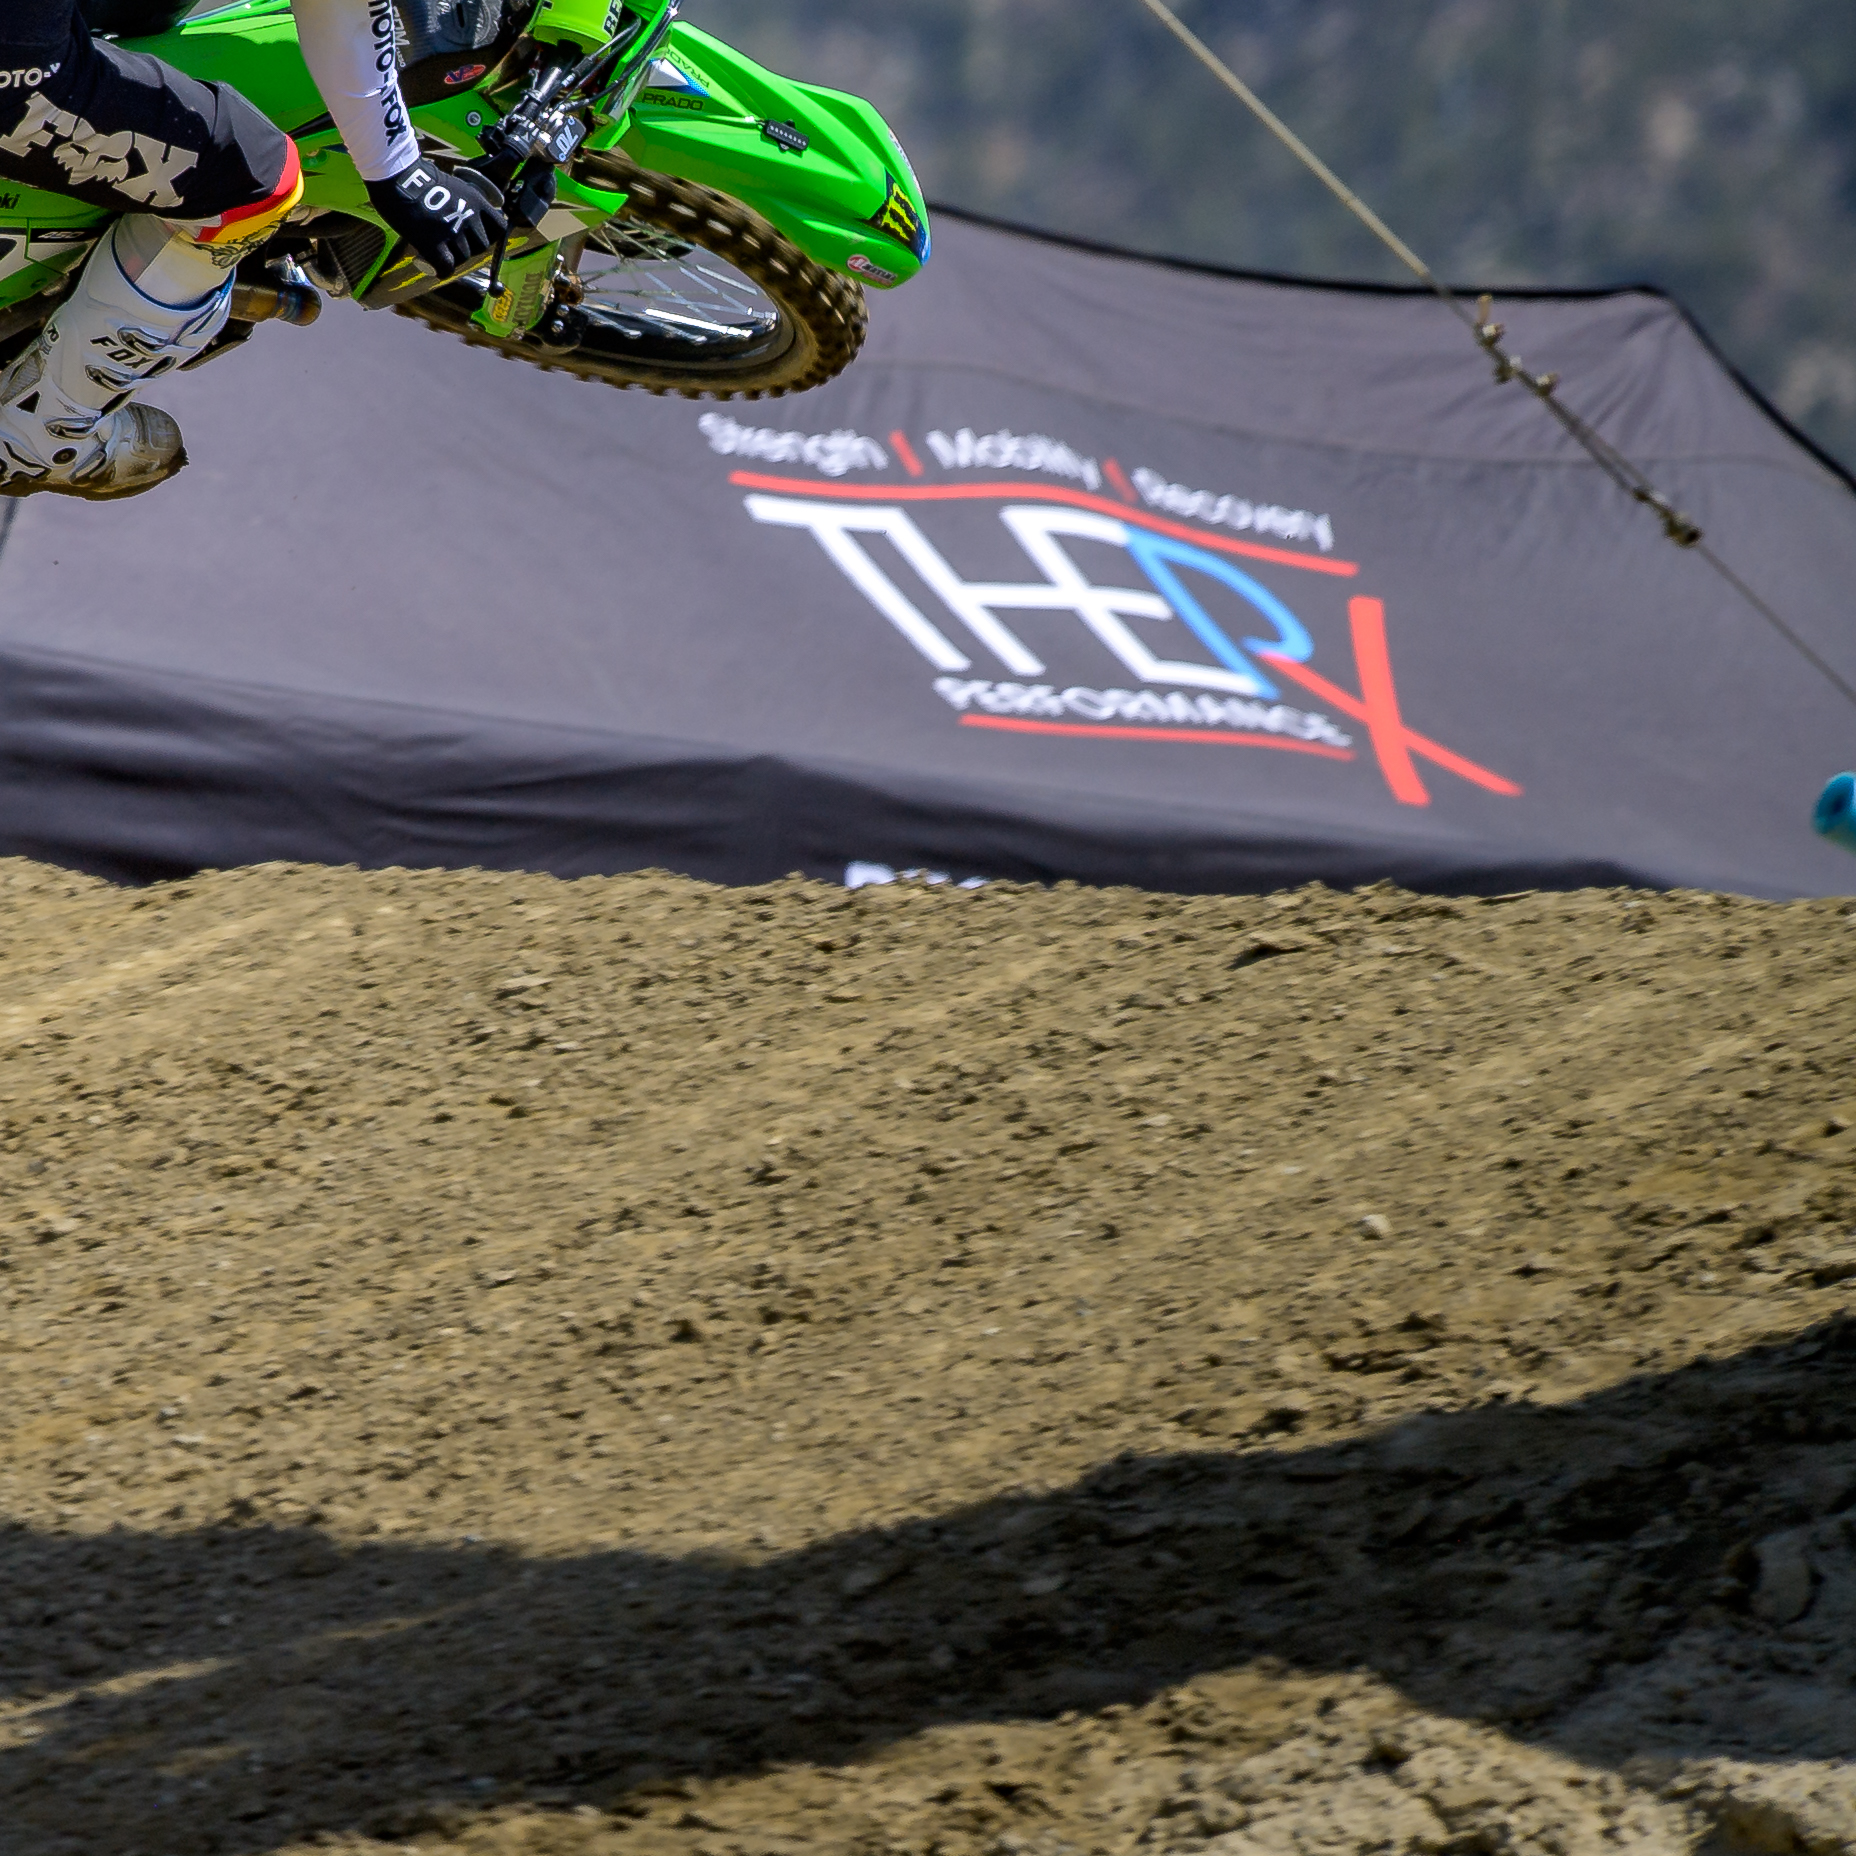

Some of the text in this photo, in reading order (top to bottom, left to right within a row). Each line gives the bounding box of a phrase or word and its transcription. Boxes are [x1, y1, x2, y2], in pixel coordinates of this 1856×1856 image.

[641, 92, 704, 111] PRADO
[401, 168, 475, 234] FOX
[90, 335, 153, 369] FOX
